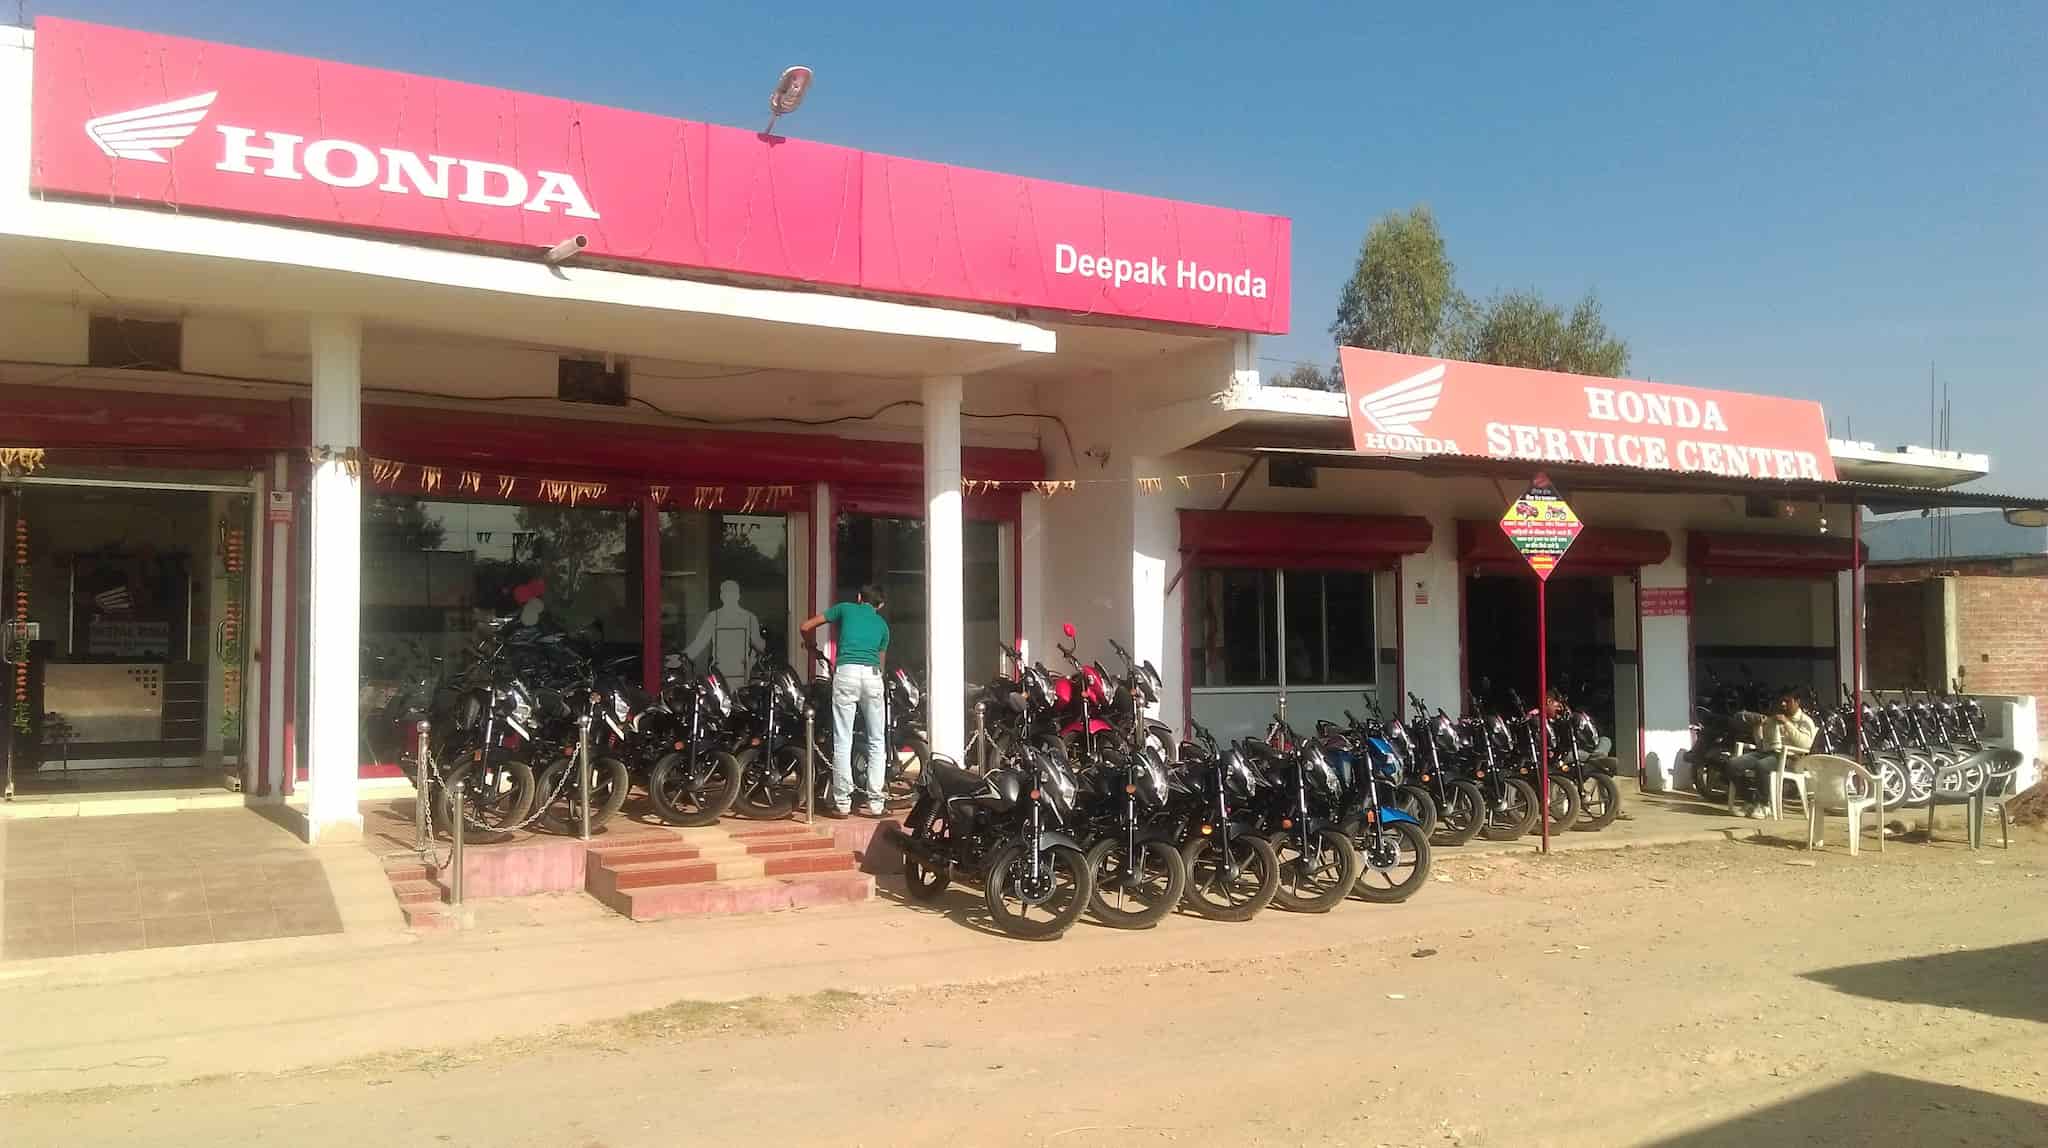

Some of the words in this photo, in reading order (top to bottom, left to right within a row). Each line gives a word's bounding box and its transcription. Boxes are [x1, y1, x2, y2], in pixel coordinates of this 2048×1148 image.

[215, 124, 601, 219] HONDA
[1055, 243, 1167, 288] Deepak
[1176, 260, 1267, 299] Honda
[1583, 386, 1729, 432] HONDA
[1365, 432, 1459, 455] HONDA
[1485, 421, 1670, 469] SERVICE
[1676, 439, 1823, 481] CENTER
